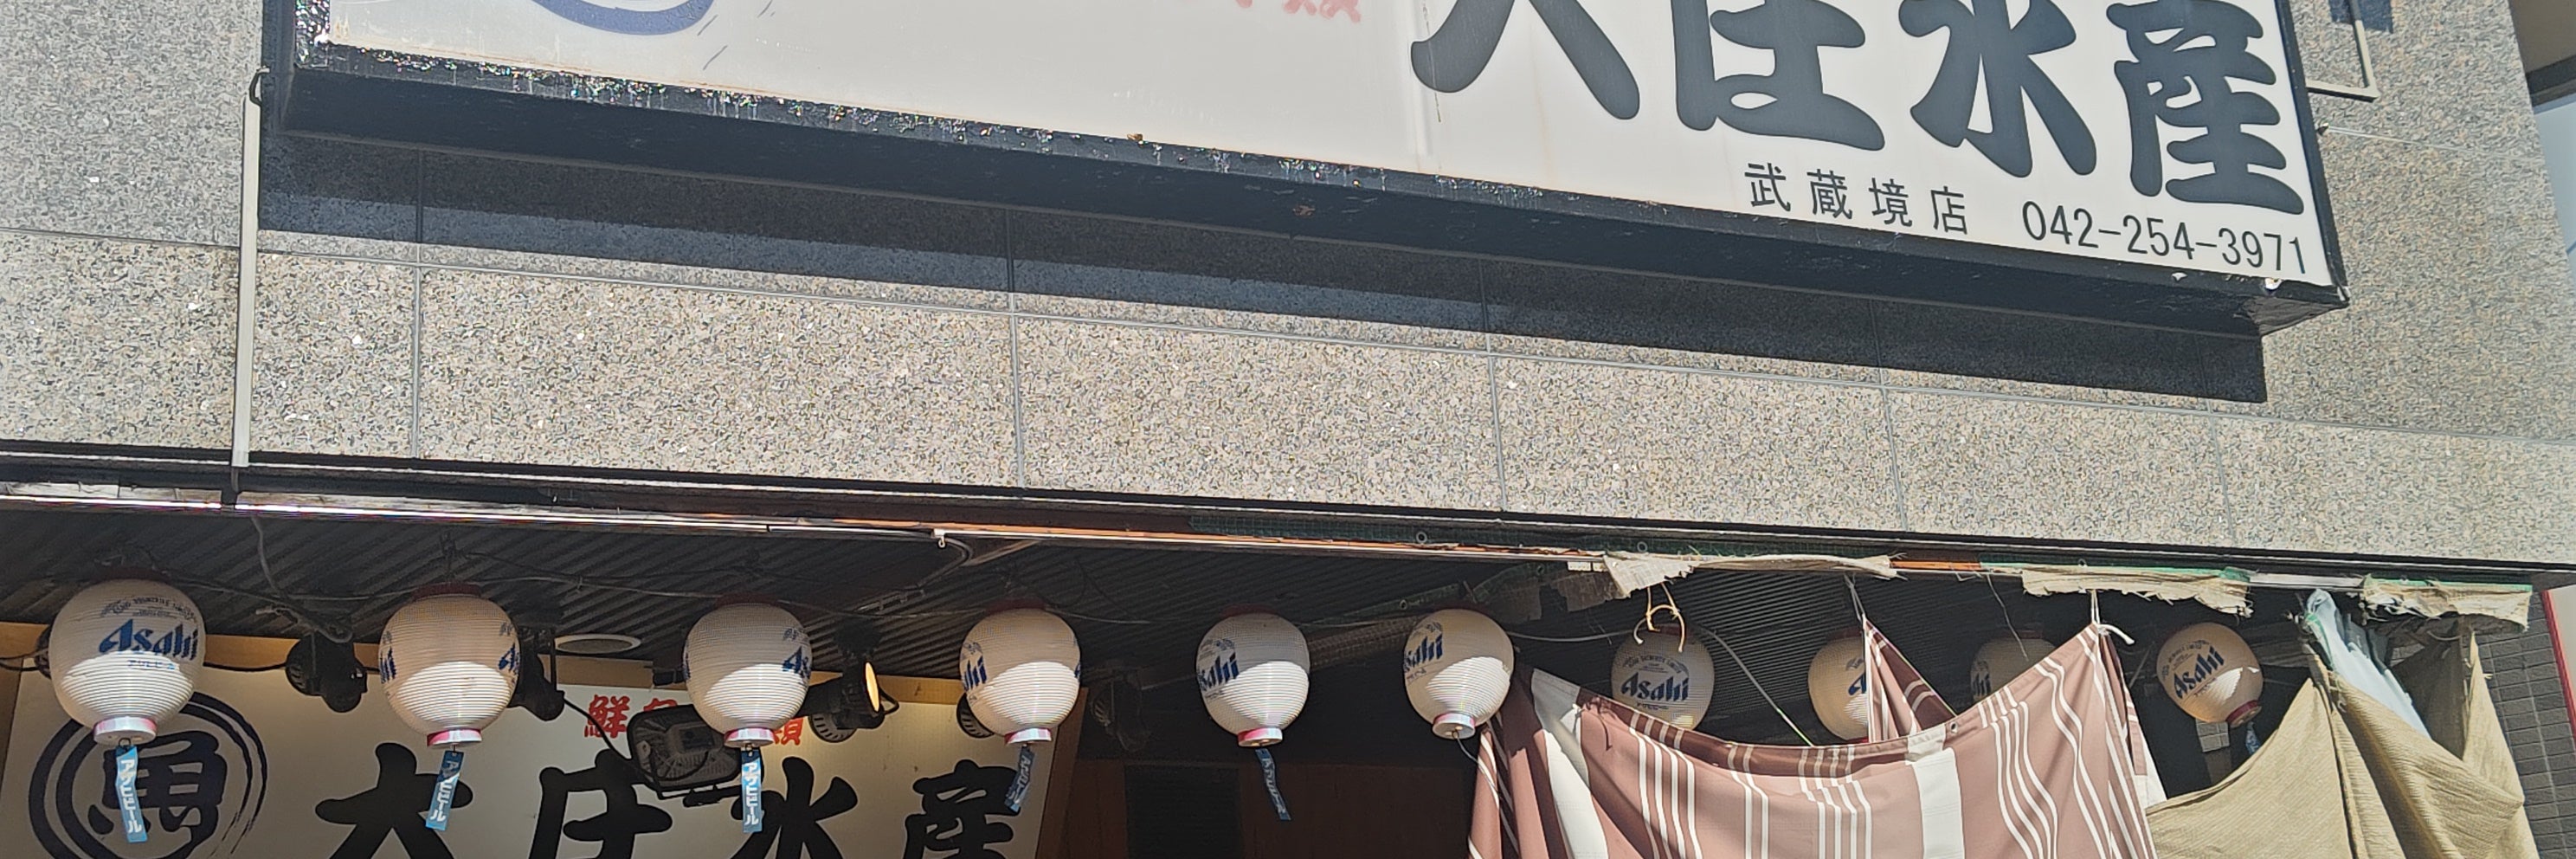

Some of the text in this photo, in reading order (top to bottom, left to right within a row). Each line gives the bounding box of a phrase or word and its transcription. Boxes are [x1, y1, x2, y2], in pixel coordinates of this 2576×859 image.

[1743, 162, 2308, 275] 武蔵境店 042-254-3971
[99, 617, 199, 661] Asahi
[1620, 671, 1690, 702] Asahi
[2173, 644, 2225, 700] Asahi
[88, 729, 228, 859] 魚
